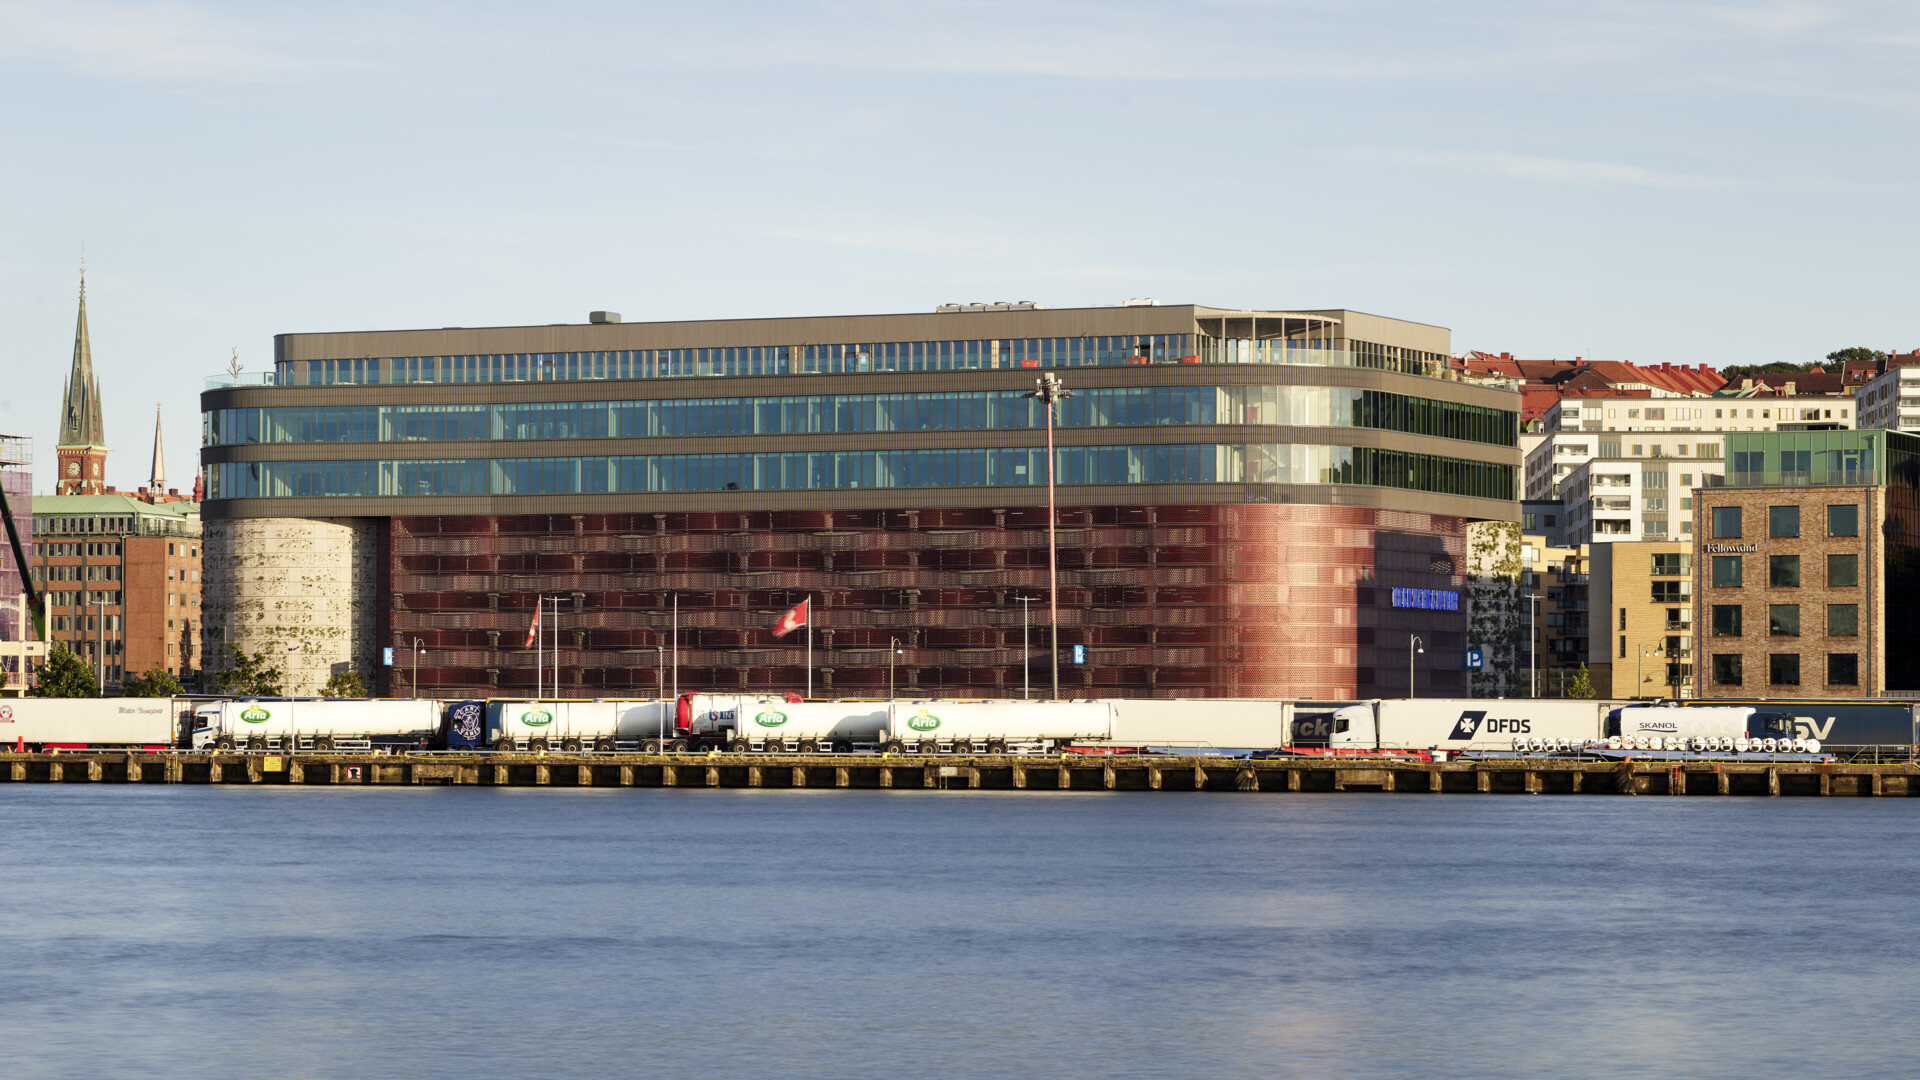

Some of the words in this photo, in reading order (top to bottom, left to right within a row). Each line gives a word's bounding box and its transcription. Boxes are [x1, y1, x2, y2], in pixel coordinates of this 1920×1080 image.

[243, 711, 267, 720] Arla
[524, 712, 549, 723] Arla
[759, 712, 784, 723] Arla
[911, 717, 937, 727] Arla
[1487, 718, 1531, 734] DFDS
